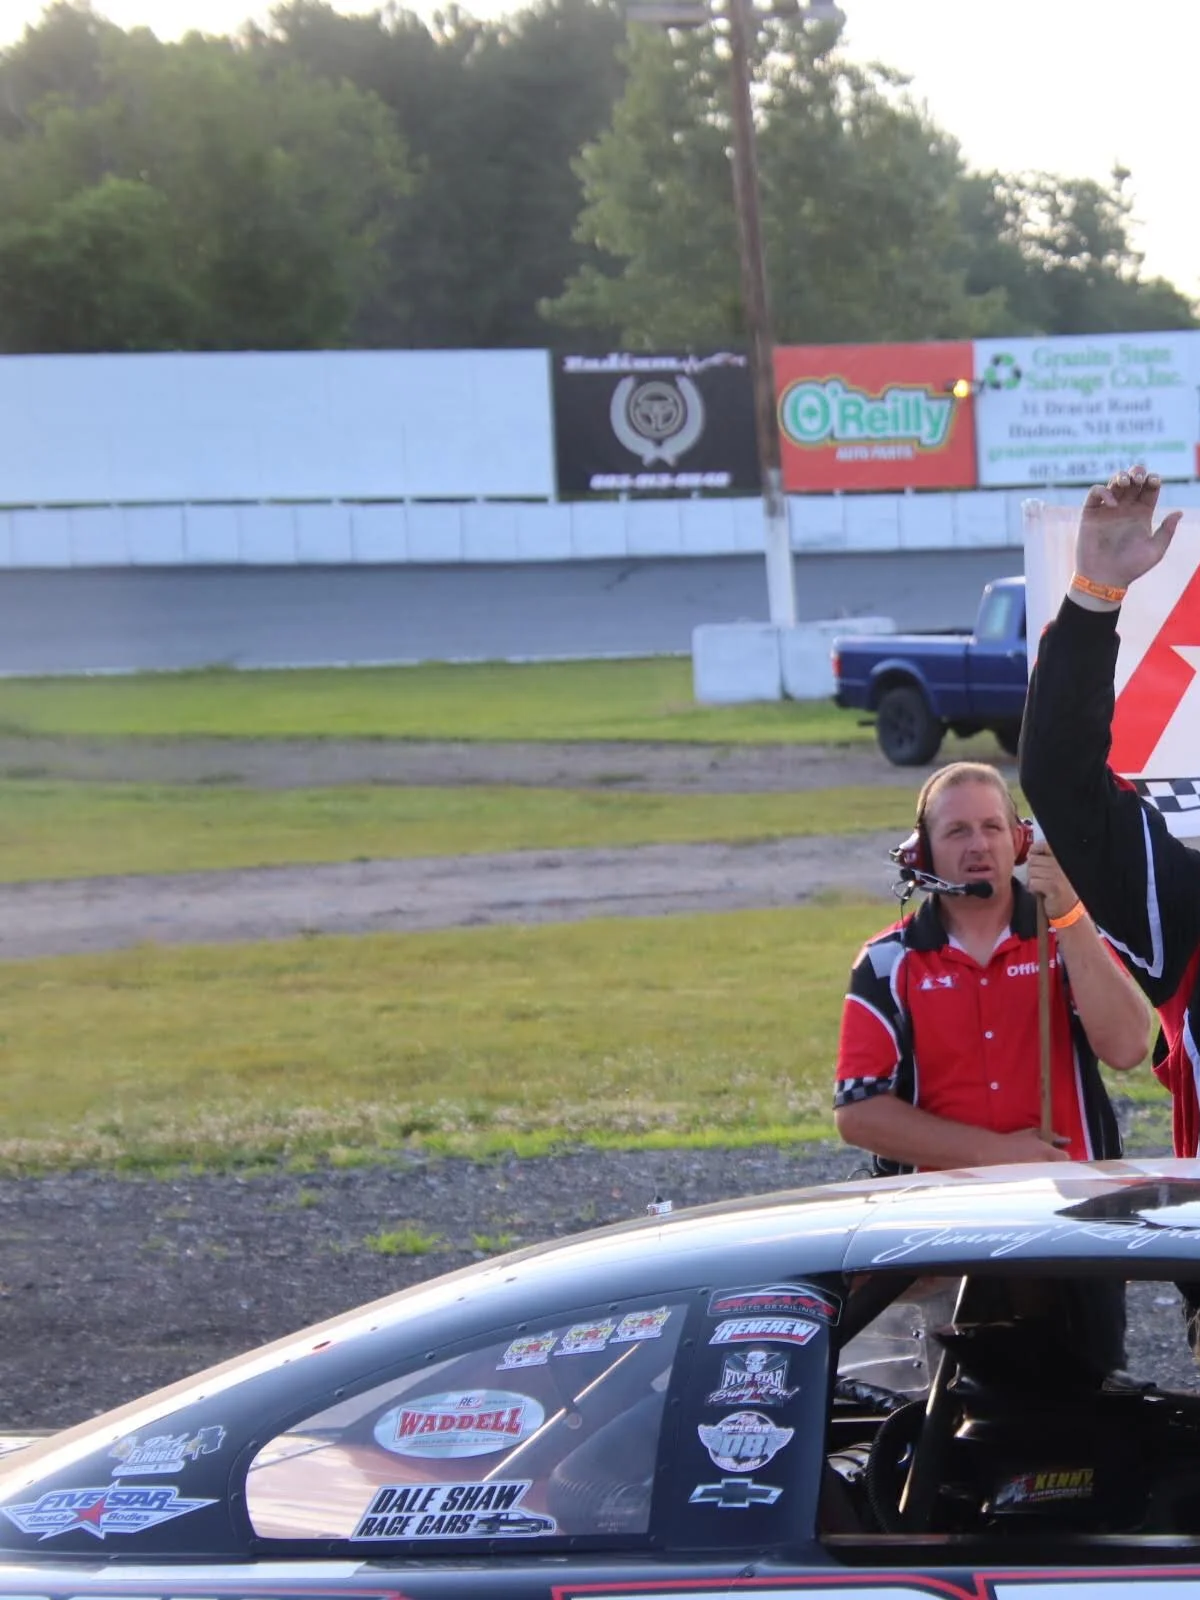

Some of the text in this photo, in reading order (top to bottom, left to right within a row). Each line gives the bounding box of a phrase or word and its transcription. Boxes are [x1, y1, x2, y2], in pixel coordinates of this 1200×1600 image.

[1032, 343, 1171, 366] Granite State
[1025, 370, 1104, 395] Salvage
[791, 387, 946, 439] O'Reilly
[764, 1304, 817, 1315] DETAILING
[721, 1320, 814, 1341] RENFREW
[723, 1369, 784, 1389] FIVE STAR
[398, 1406, 524, 1438] WADDELL
[34, 1491, 173, 1511] FIVE STAR
[371, 1485, 525, 1514] DALE SHAW
[106, 1512, 150, 1522] Bodies
[357, 1514, 476, 1537] RACE CARS
